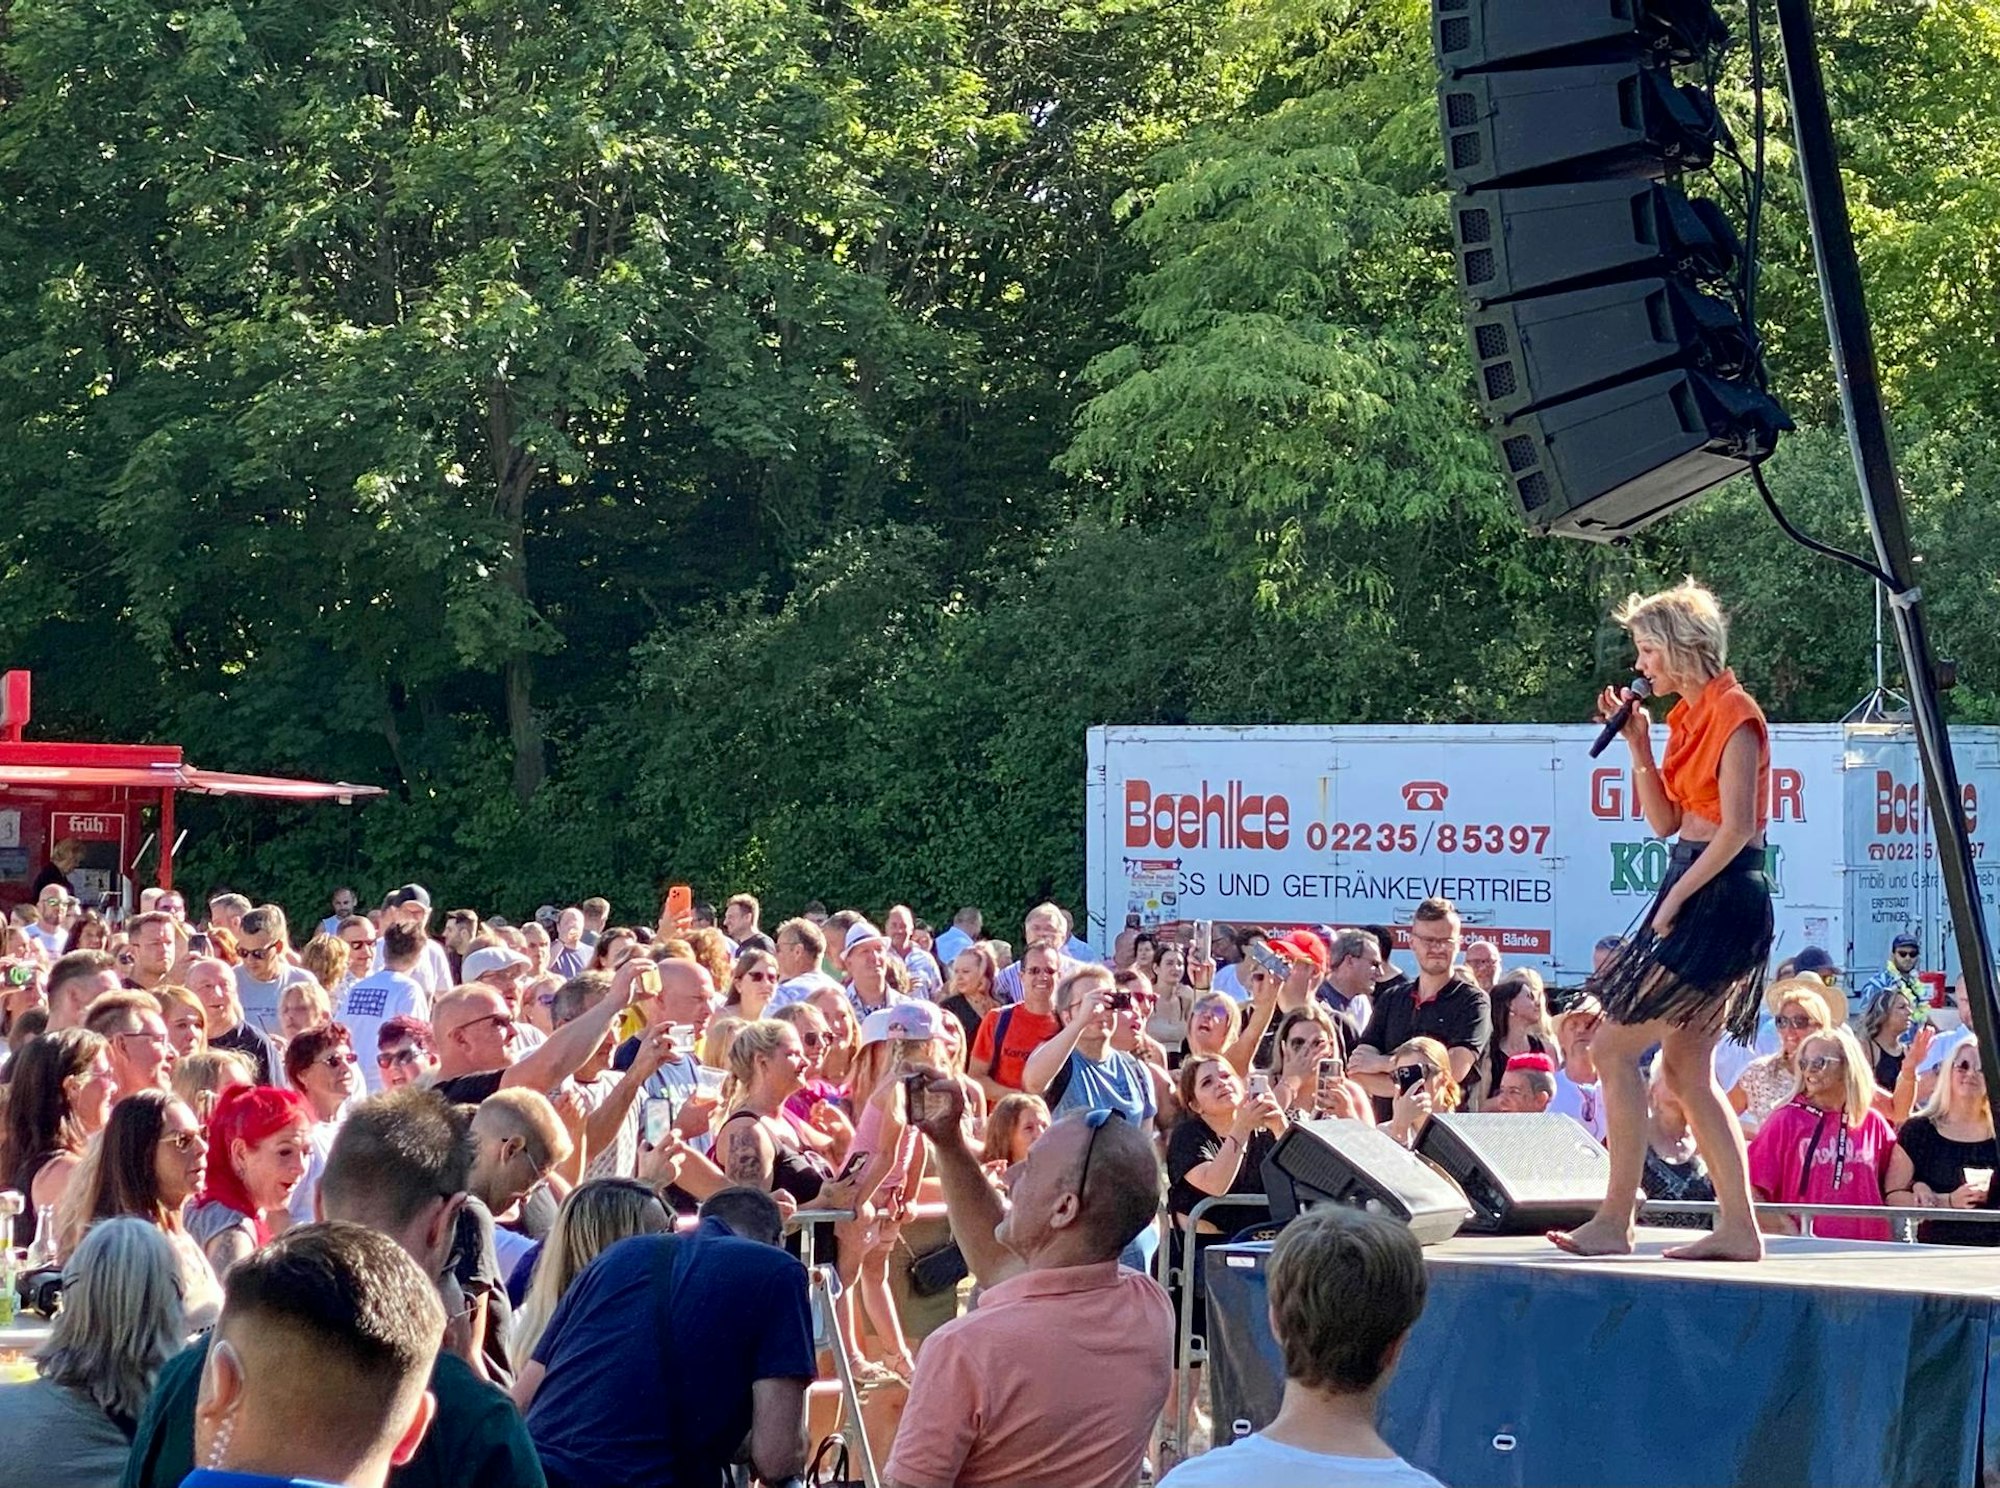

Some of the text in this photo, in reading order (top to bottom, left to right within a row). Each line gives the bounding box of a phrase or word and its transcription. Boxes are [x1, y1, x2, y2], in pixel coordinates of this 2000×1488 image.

[1125, 779, 1290, 850] Boehlke
[1876, 770, 1978, 834] Boee
[1306, 820, 1551, 857] 02235/85397
[1179, 869, 1552, 903] SS UND GETRÄNKEVERTRIEB
[1889, 873, 1908, 889] und
[1459, 931, 1486, 945] sche
[1502, 932, 1539, 947] Bänke
